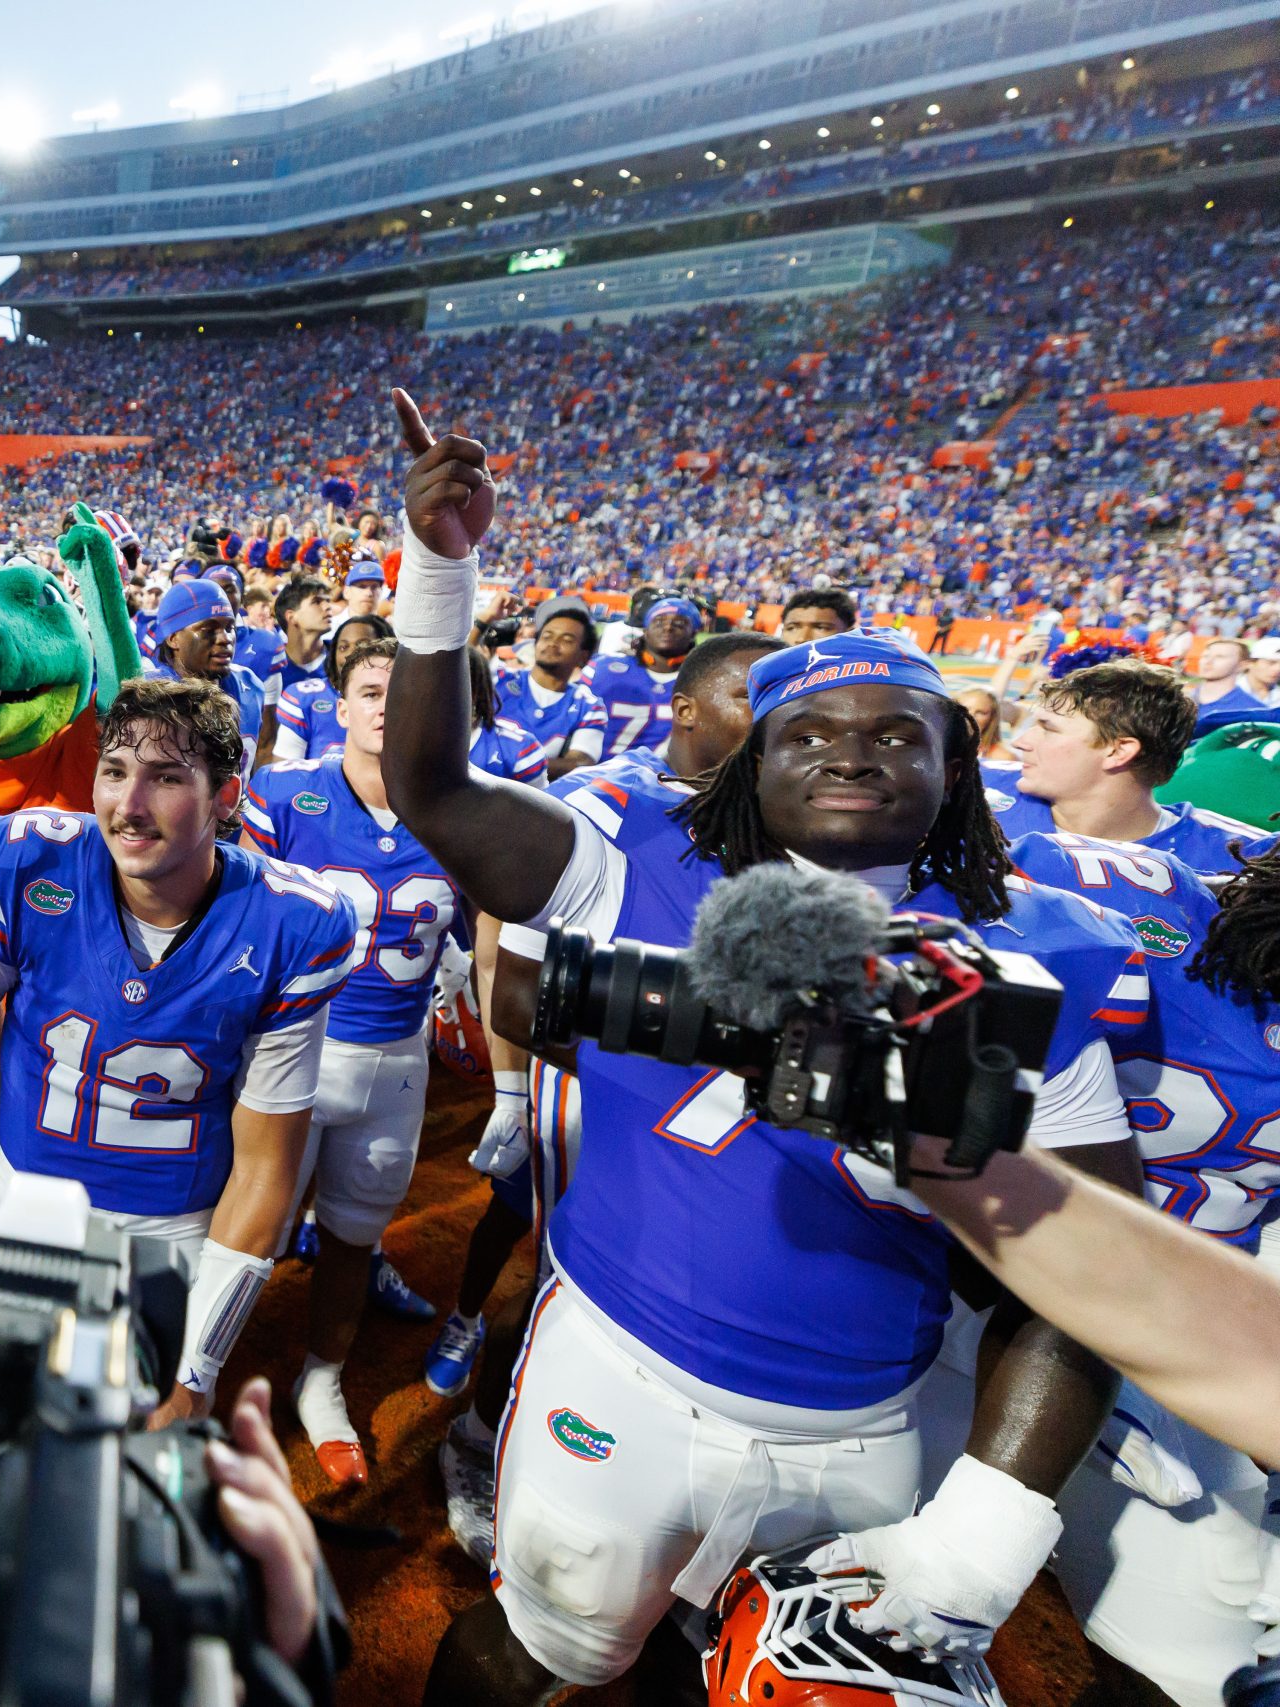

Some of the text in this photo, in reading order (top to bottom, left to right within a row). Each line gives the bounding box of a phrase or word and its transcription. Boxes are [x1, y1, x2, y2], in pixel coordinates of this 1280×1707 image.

[778, 661, 891, 700] FLORIDA
[123, 982, 147, 1003] SEC
[36, 1010, 212, 1155] 12
